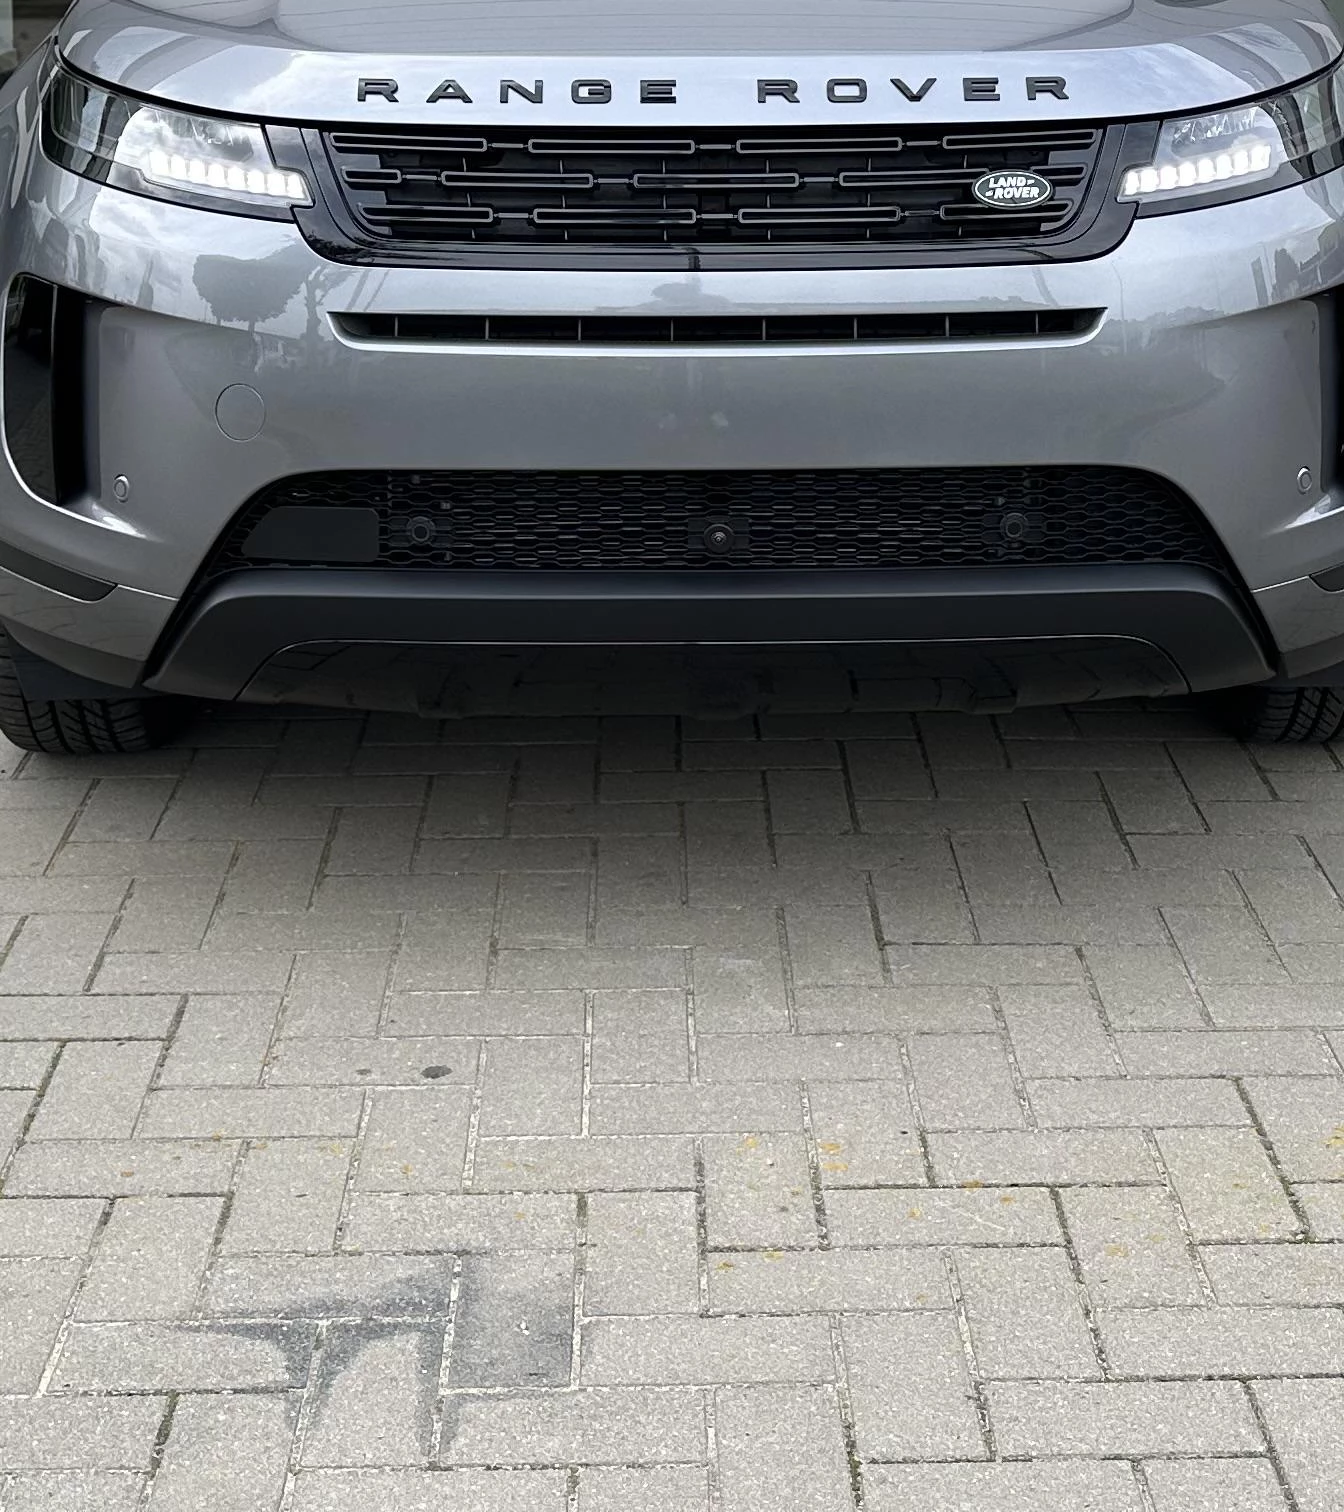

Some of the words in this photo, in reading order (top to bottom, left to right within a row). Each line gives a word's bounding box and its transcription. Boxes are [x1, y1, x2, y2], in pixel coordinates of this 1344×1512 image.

[356, 77, 678, 105] RANGE
[756, 75, 1071, 105] ROVER
[988, 176, 1027, 188] LAND
[993, 186, 1040, 200] ROVER
